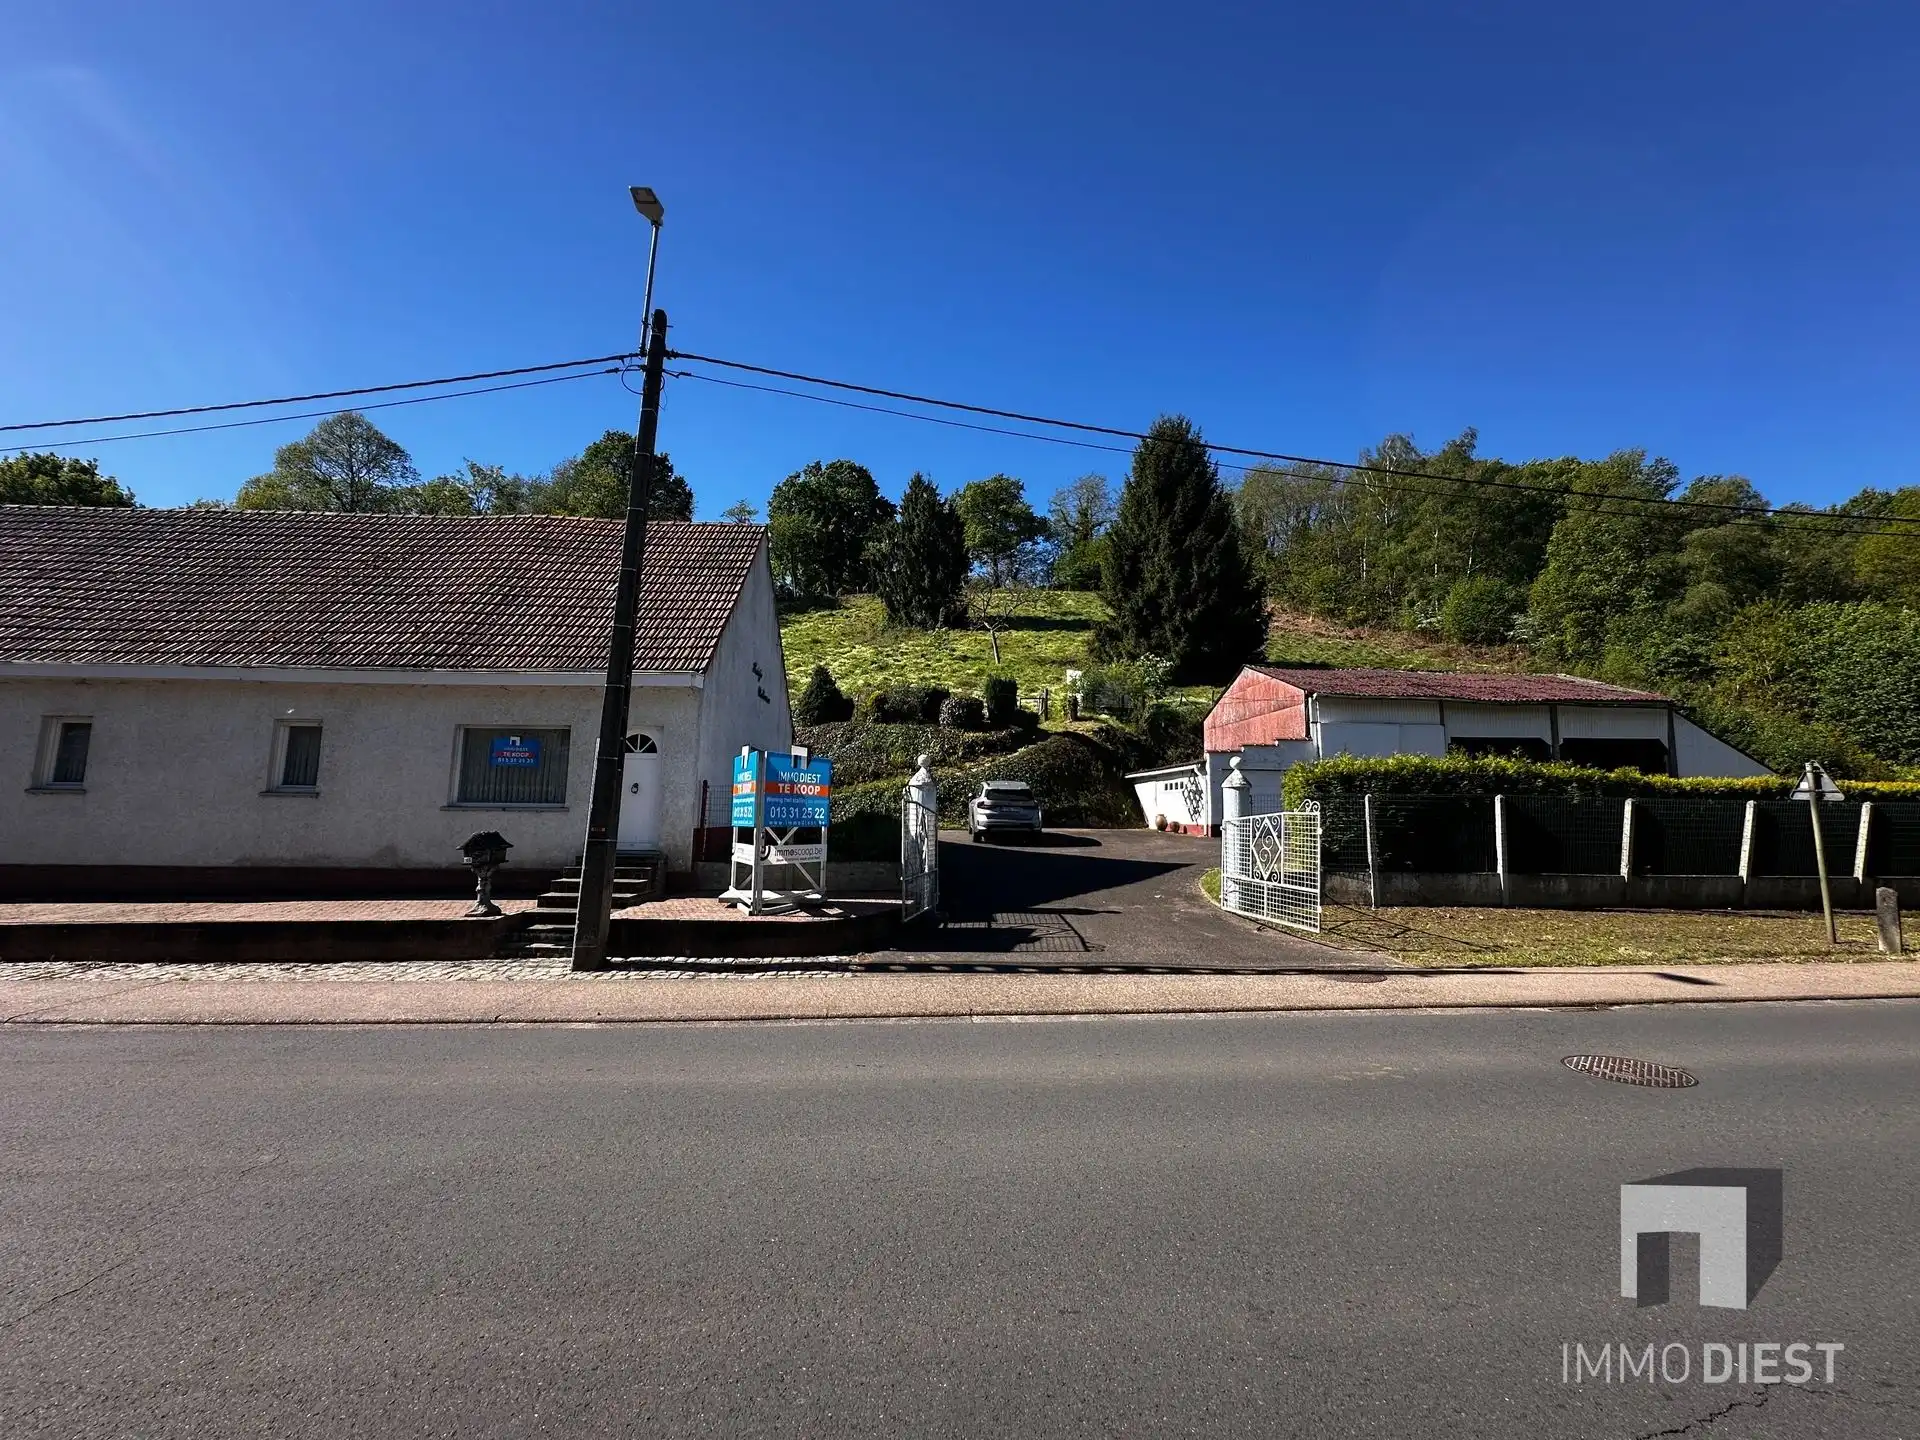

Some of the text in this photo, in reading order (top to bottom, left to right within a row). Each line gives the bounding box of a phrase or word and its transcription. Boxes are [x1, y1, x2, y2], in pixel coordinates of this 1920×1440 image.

[778, 783, 821, 795] TE KOOP
[770, 806, 825, 819] 013 31 25 22
[774, 847, 823, 857] immoscoop.be
